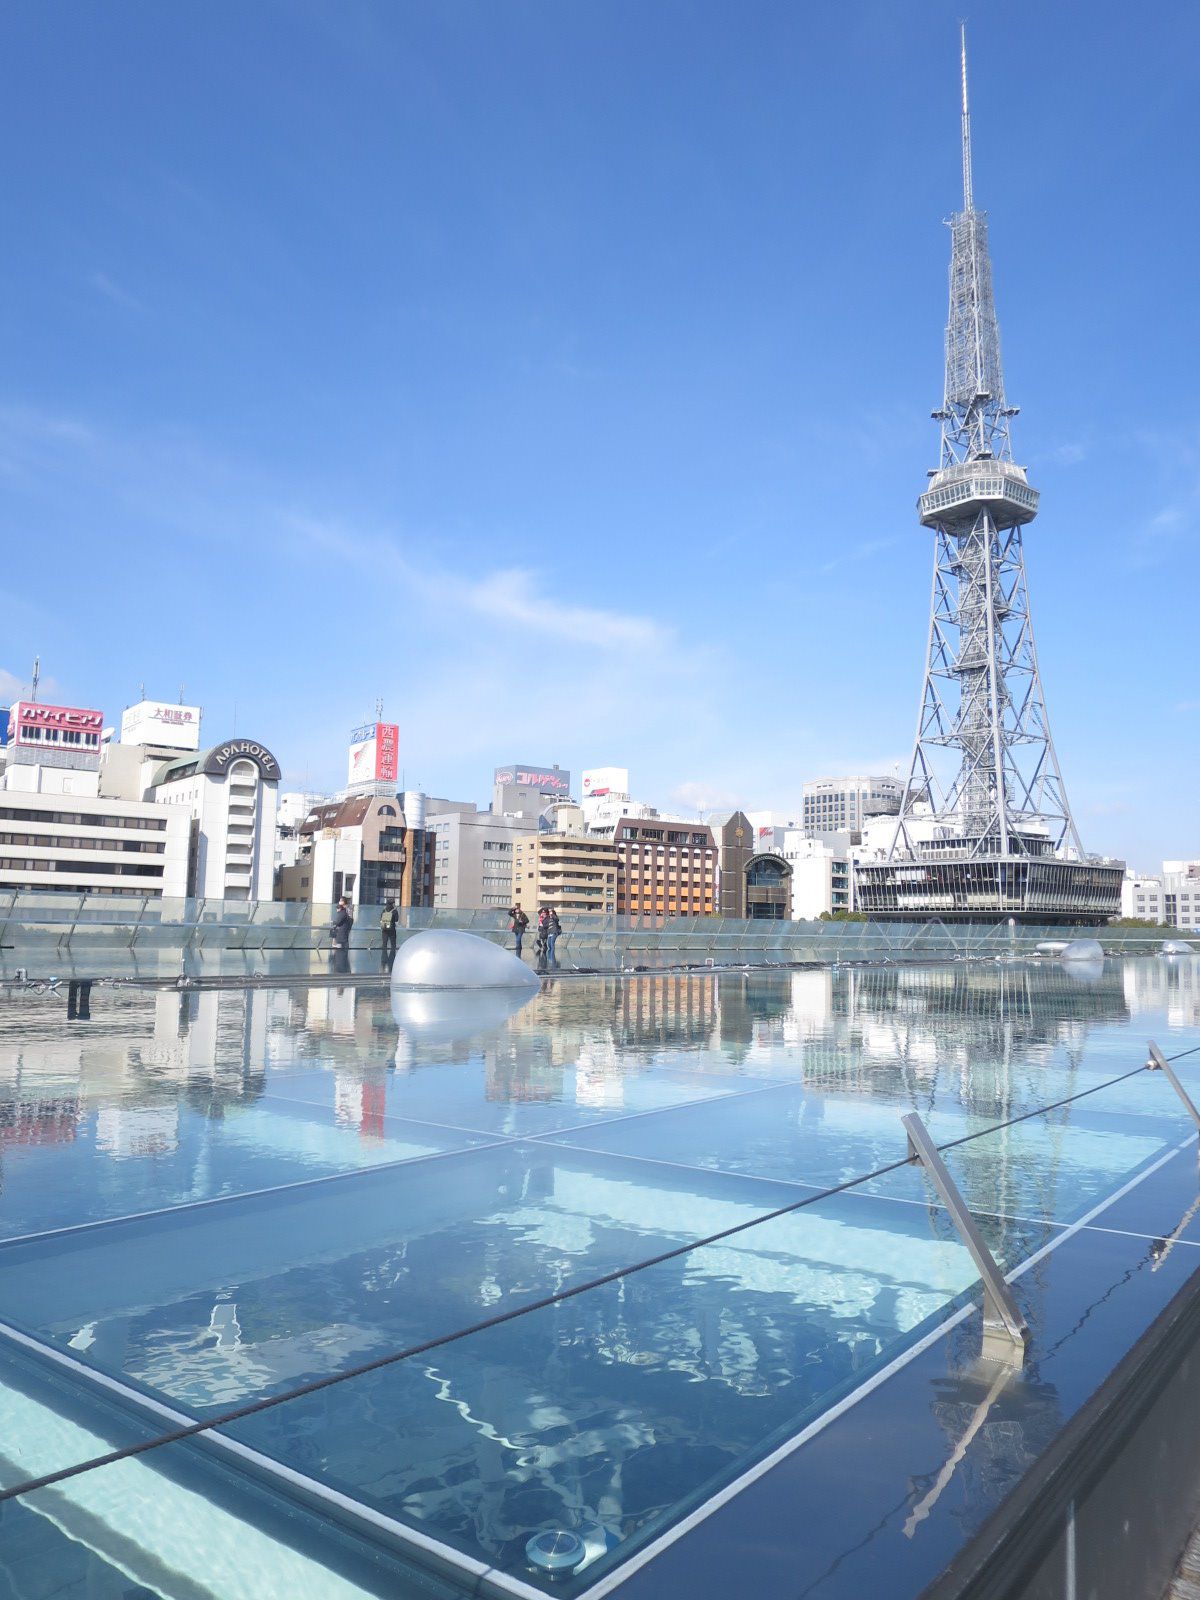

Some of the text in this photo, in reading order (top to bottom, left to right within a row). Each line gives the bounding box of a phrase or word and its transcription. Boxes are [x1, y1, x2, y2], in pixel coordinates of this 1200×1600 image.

[154, 707, 193, 721] 大和証券
[215, 742, 275, 771] APA HOTEL
